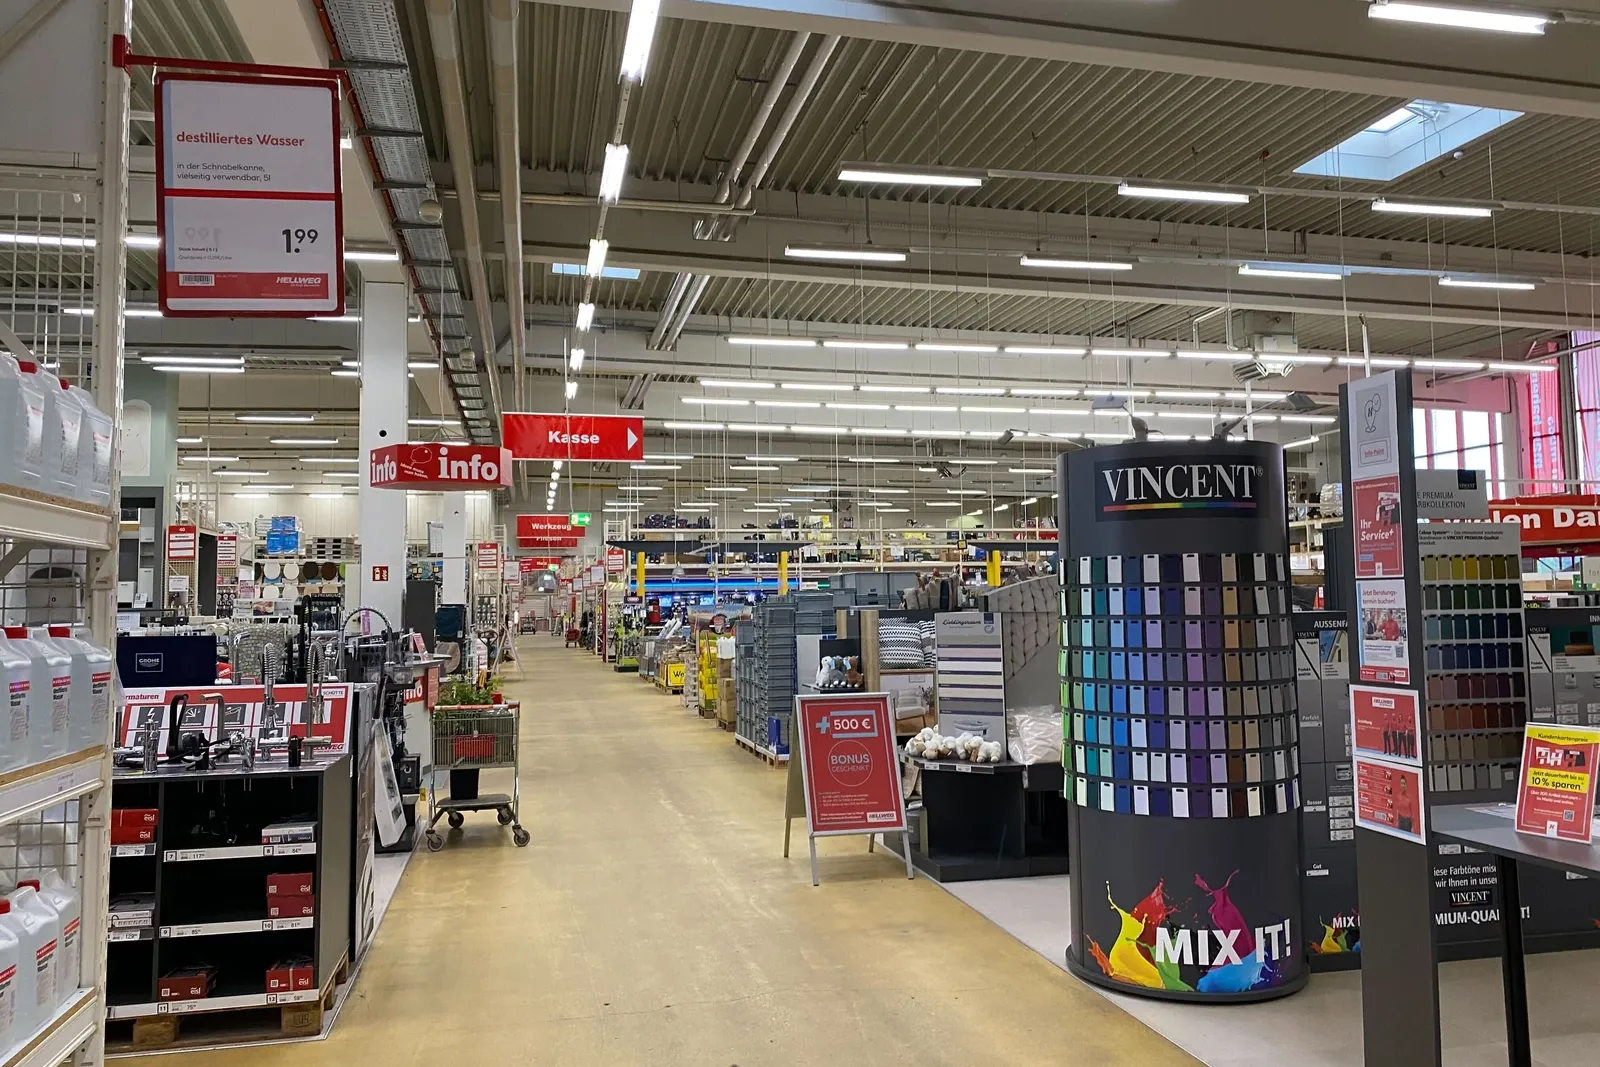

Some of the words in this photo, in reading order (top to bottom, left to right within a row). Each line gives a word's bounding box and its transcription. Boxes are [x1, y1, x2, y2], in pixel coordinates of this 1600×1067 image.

[176, 131, 253, 145] destilliertes
[256, 133, 305, 147] Wasser
[186, 162, 200, 170] der
[202, 163, 265, 172] Schnabelkanne,
[176, 173, 211, 181] vielseitig
[212, 174, 262, 182] verwendbar,
[276, 276, 321, 284] HELLWEG
[548, 430, 600, 445] Kasse
[371, 452, 397, 484] info
[438, 446, 498, 481] info
[1422, 491, 1454, 499] PREMIUM
[1417, 500, 1466, 509] RBKOLLEKTION
[531, 523, 572, 532] Werkzeug
[1360, 519, 1372, 529] Ihr
[833, 718, 859, 730] 500
[862, 718, 871, 729] €
[1537, 733, 1588, 743] Kundenkartenpreis
[830, 754, 870, 765] BONUS
[831, 764, 870, 773] GESCHENKT
[1544, 771, 1569, 779] dauerhaft
[1531, 776, 1541, 785] 10
[1541, 777, 1550, 786] %
[1449, 865, 1480, 876] Farbtöne
[1435, 879, 1447, 888] wir
[1448, 878, 1469, 887] Ihnen
[1470, 876, 1478, 886] in
[1332, 916, 1355, 929] MIX
[1155, 927, 1243, 966] MIX
[1255, 918, 1291, 964] IT!
